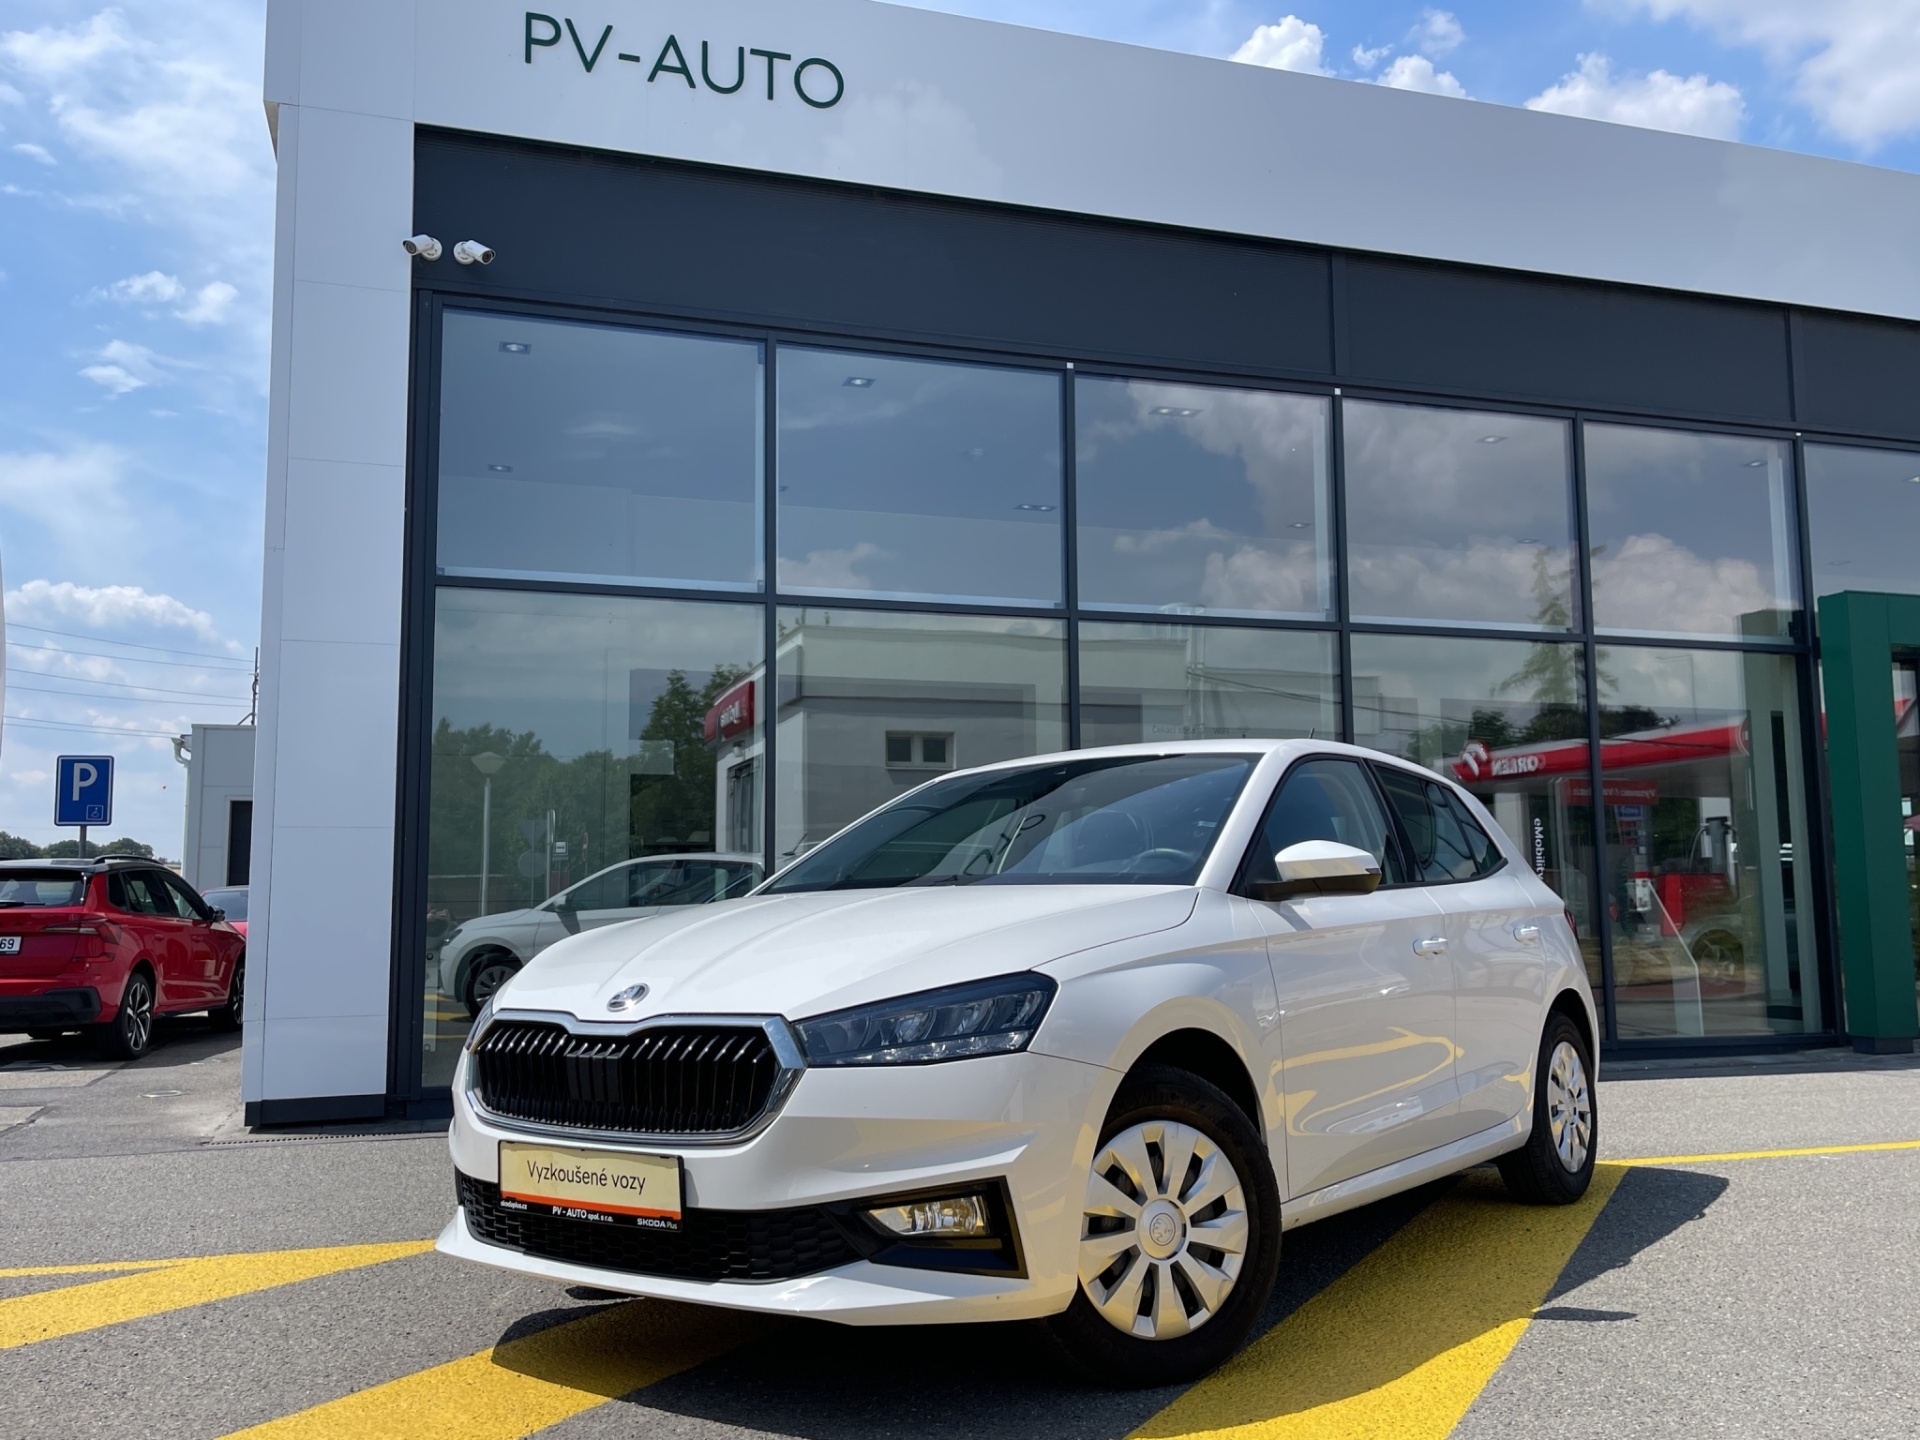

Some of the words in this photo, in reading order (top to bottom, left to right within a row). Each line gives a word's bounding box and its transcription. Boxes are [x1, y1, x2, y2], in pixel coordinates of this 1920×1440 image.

[525, 11, 845, 109] PV-AUTO
[72, 762, 98, 801] P
[526, 1159, 608, 1187] Vyzkoušené
[611, 1173, 646, 1195] vozy
[566, 1209, 587, 1219] AUTO
